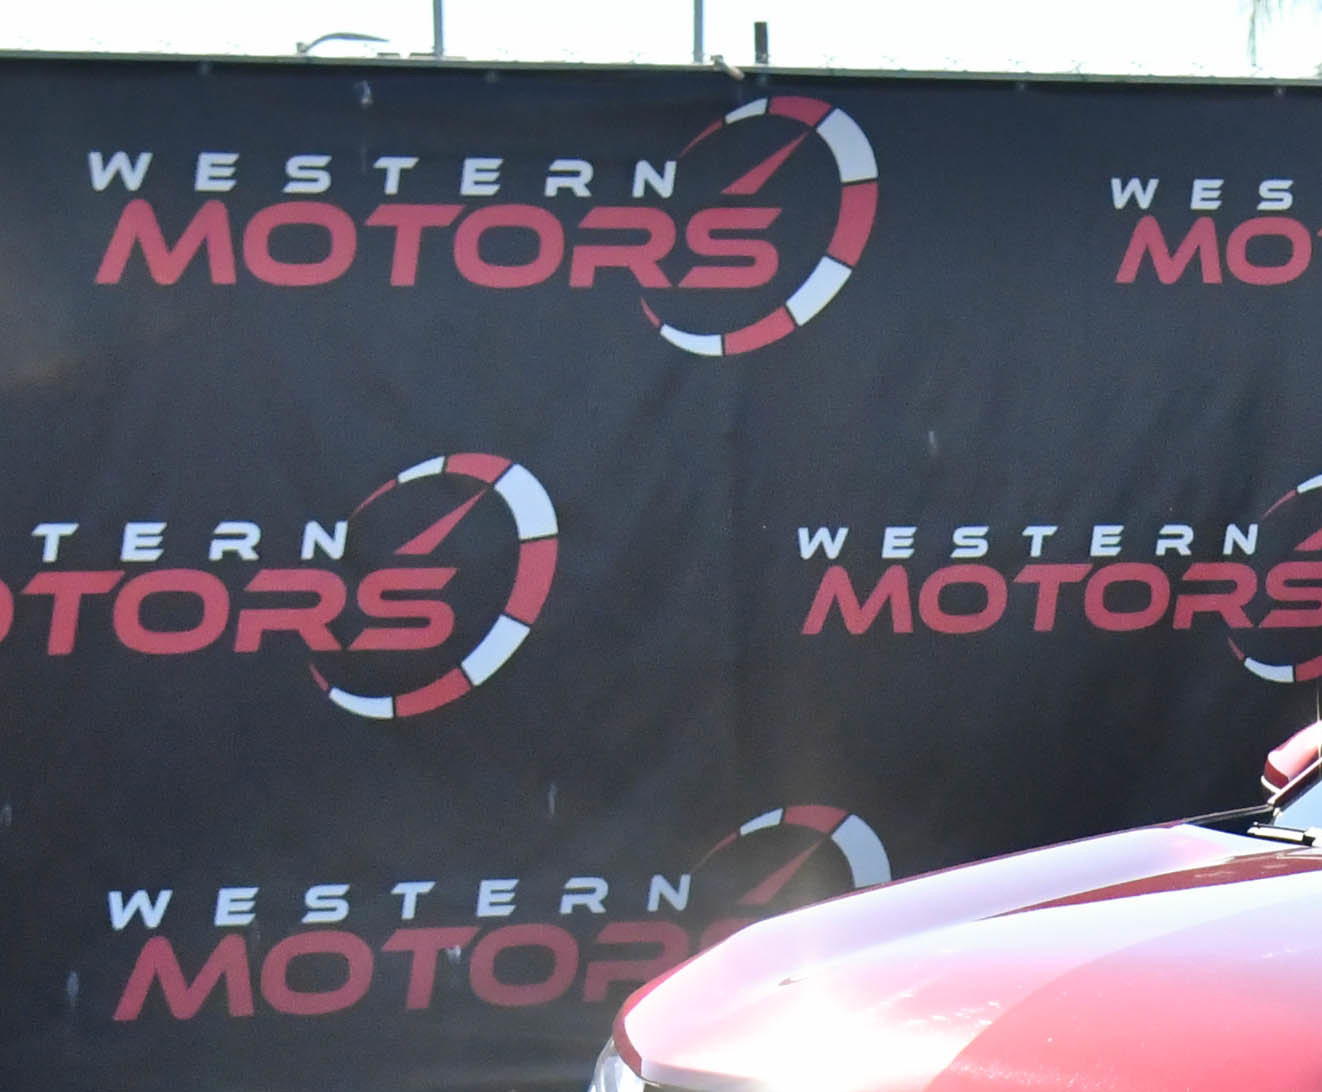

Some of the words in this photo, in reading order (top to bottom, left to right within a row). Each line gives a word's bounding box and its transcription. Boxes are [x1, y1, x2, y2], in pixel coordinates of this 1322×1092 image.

[89, 151, 678, 199] WESTERN
[95, 199, 783, 289] MOTORS
[797, 523, 1259, 559] WESTERN
[0, 567, 457, 656] TORS
[108, 874, 692, 930] WESTERN
[112, 917, 754, 1021] MOTOR
